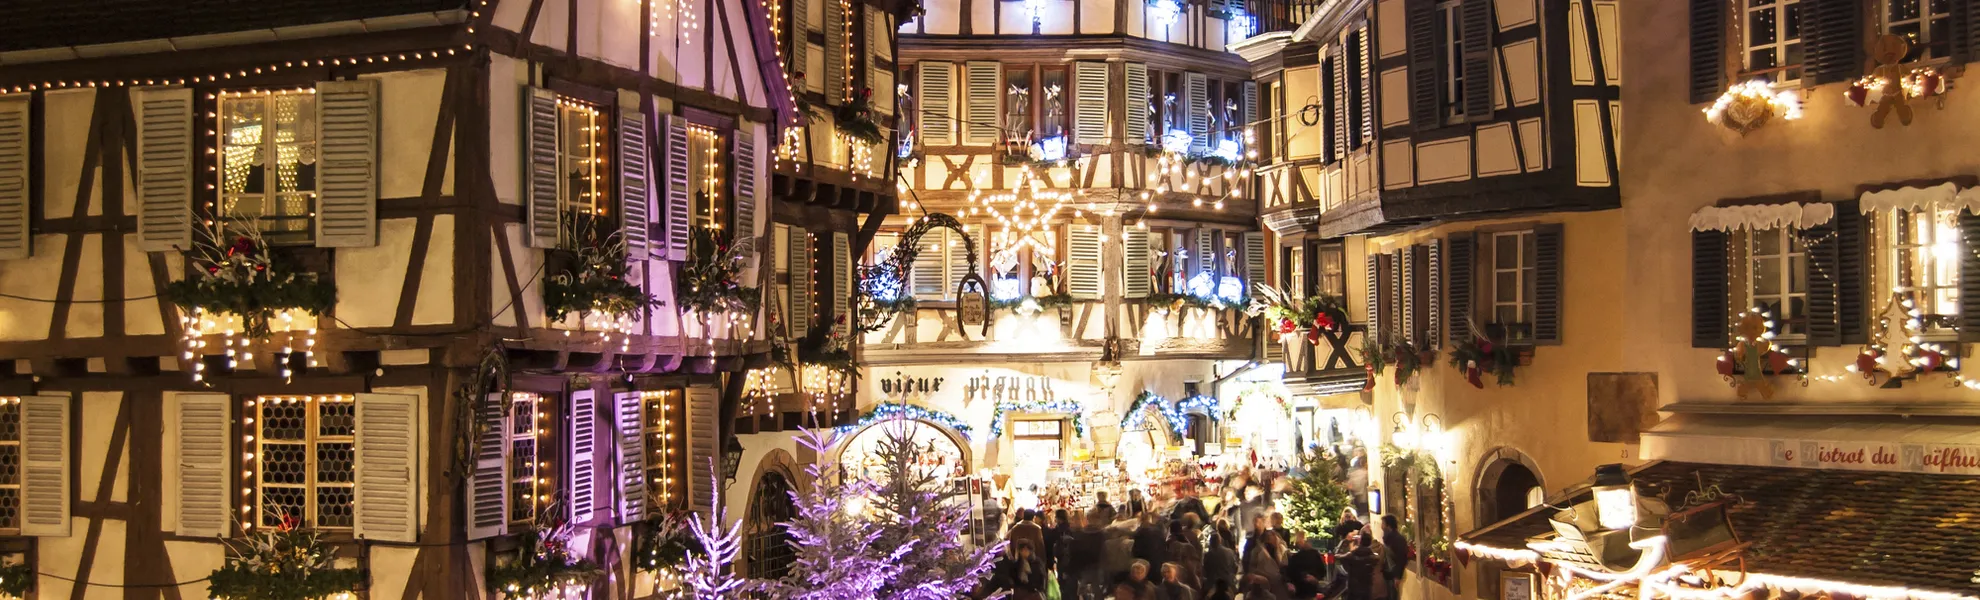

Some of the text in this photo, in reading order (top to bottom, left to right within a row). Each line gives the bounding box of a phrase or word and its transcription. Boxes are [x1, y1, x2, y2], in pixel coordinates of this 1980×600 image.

[1773, 442, 1794, 461] Le
[1803, 443, 1865, 464] Bistrot
[1871, 446, 1897, 465] du
